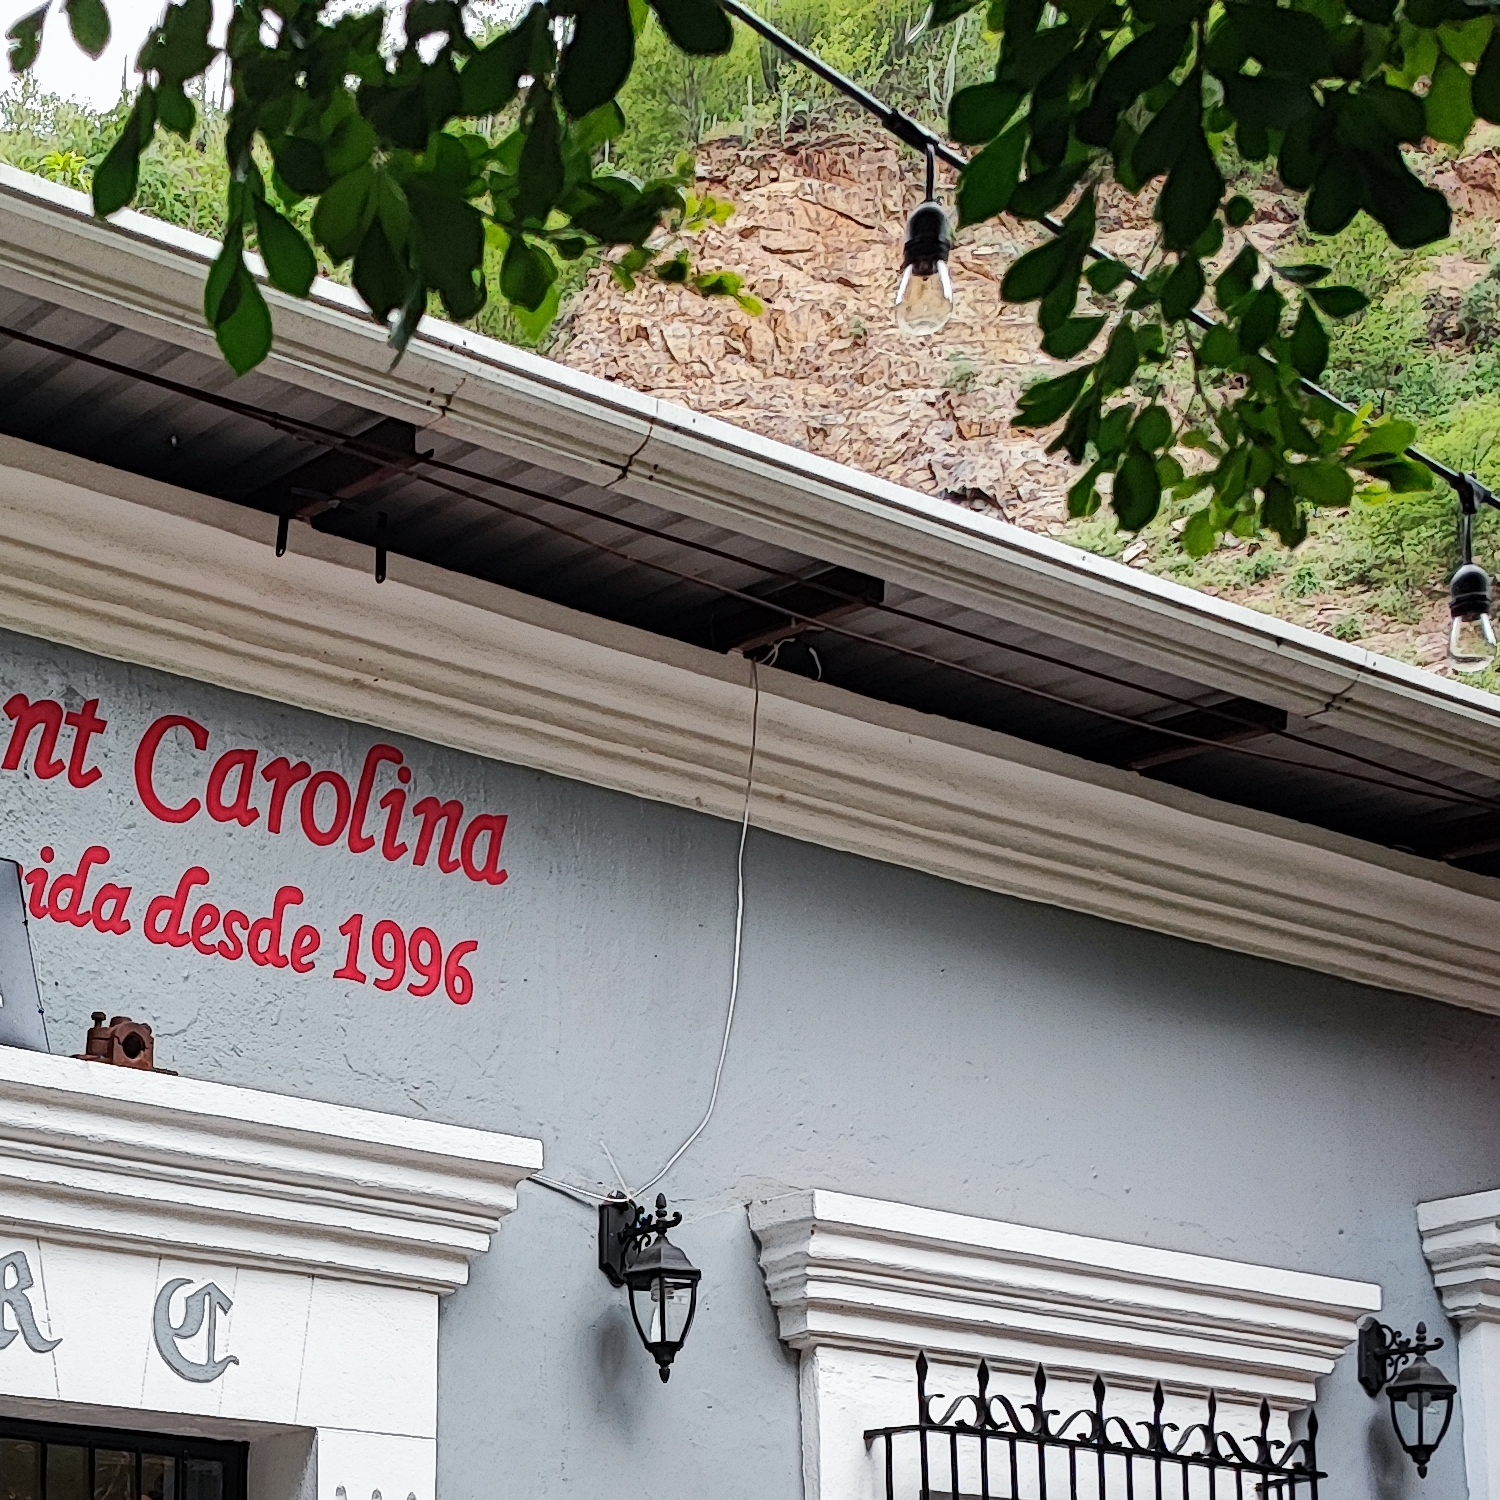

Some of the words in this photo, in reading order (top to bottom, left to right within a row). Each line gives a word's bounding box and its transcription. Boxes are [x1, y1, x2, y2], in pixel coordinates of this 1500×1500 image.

[133, 714, 510, 887] Carolina
[142, 865, 322, 975] desde
[332, 912, 480, 1006] 1996
[152, 1277, 240, 1384] C
